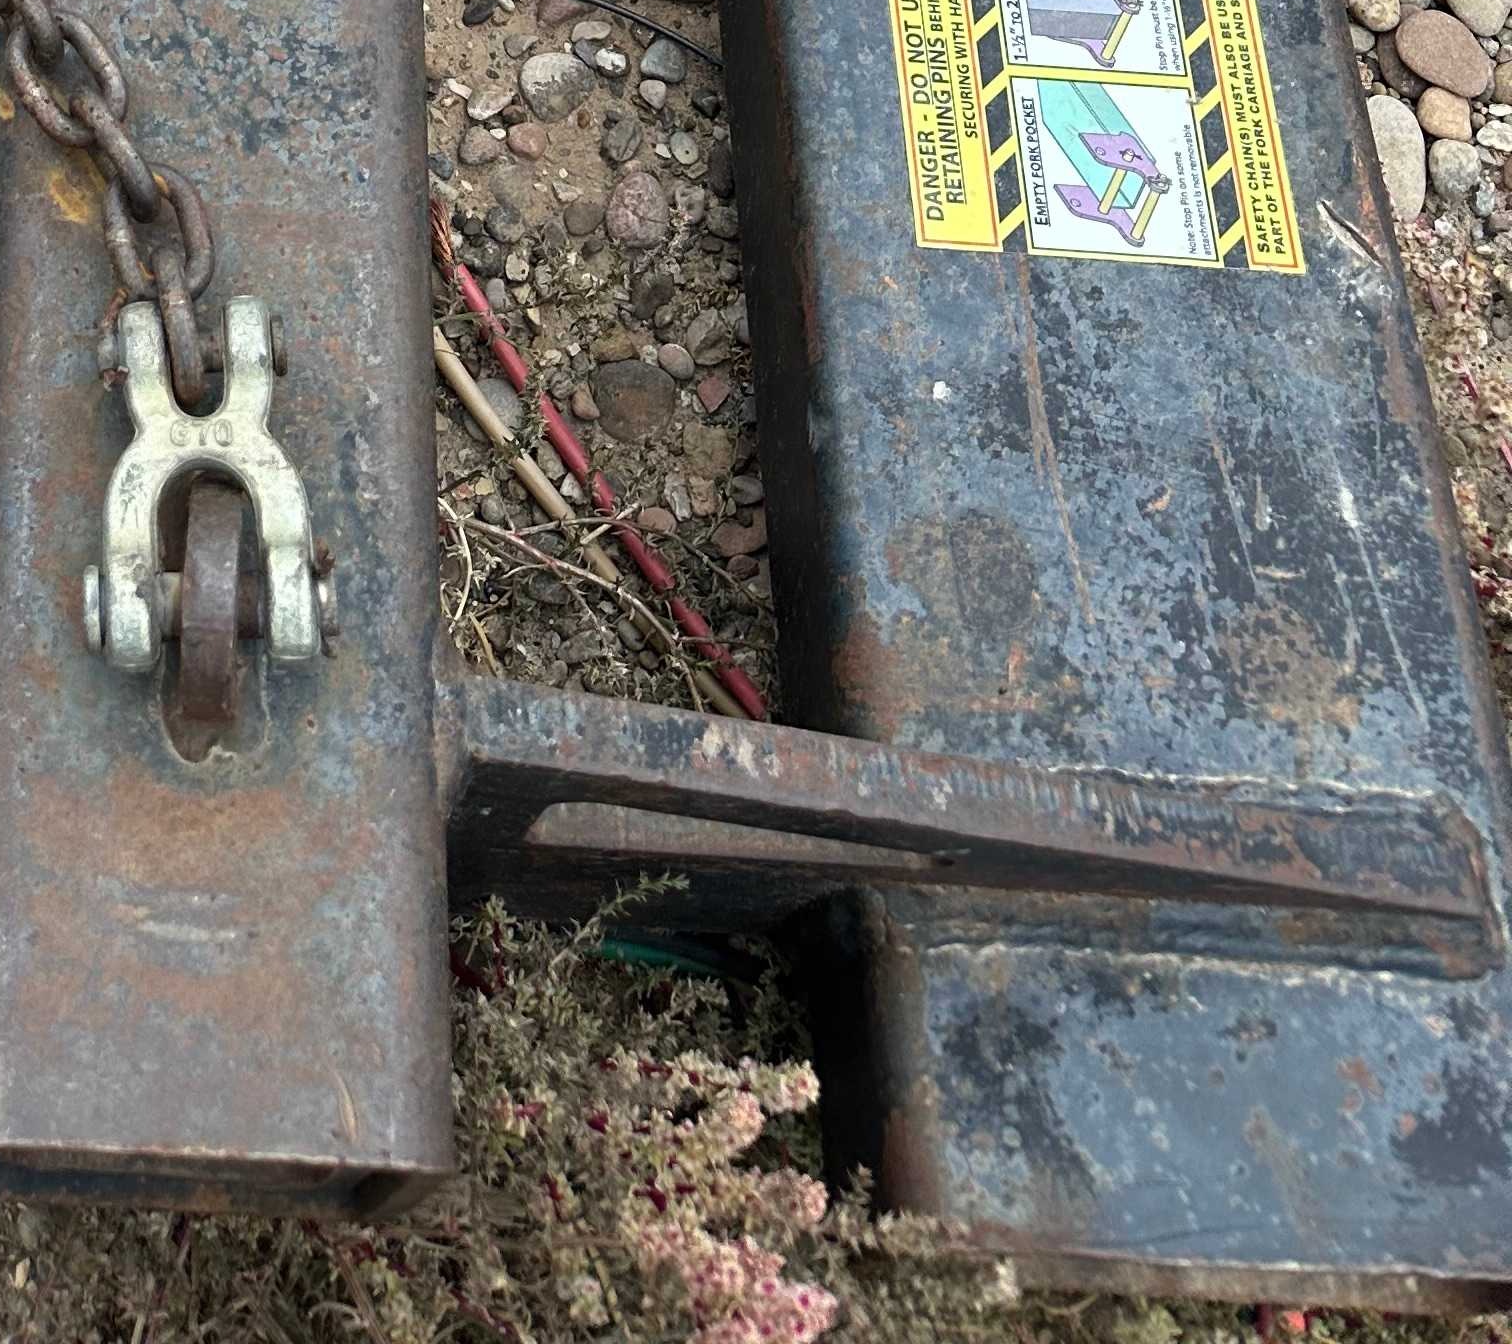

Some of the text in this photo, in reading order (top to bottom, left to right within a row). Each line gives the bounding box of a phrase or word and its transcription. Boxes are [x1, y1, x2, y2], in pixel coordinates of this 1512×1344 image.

[903, 19, 926, 63] NOT
[950, 20, 968, 59] WITH
[1218, 21, 1232, 39] BE
[1232, 11, 1247, 40] AND
[926, 36, 950, 84] PINS
[1223, 43, 1240, 79] ALSO
[1237, 43, 1260, 114] CARRIAGE
[910, 72, 931, 105] DO
[955, 63, 978, 138] SECURING
[1230, 82, 1247, 122] MUST
[932, 89, 964, 204] RETAINING
[1251, 118, 1268, 156] FORK
[916, 130, 945, 221] DANGER
[1020, 95, 1049, 226] EMPTY FORK POCKET
[1237, 126, 1259, 191] CHAIN(S)
[1258, 160, 1274, 189] THE
[1264, 193, 1278, 213] OF
[1249, 194, 1270, 253] SAFETY
[1269, 216, 1286, 254] PART
